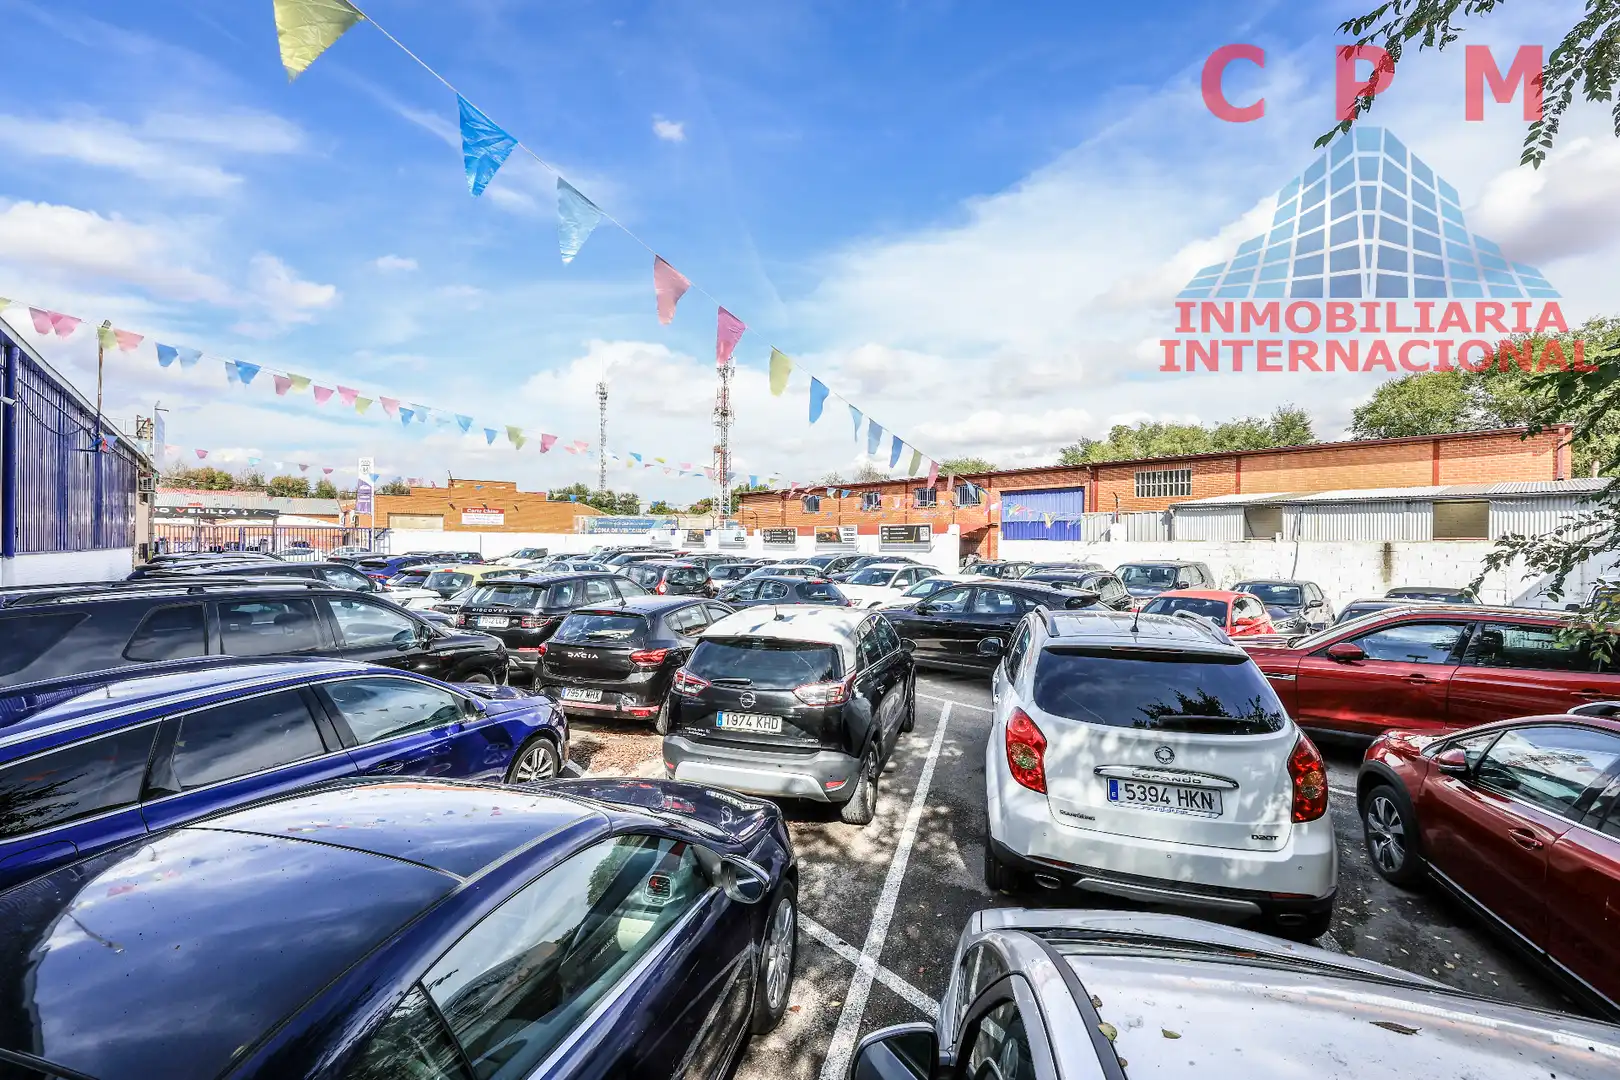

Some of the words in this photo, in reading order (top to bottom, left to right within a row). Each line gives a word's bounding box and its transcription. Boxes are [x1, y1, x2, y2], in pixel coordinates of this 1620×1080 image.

[176, 507, 237, 515] VELILLA
[567, 651, 599, 659] DACIA
[725, 714, 752, 728] 1974
[756, 715, 779, 730] KHD
[1124, 783, 1171, 804] 5394
[1177, 788, 1214, 810] HKN
